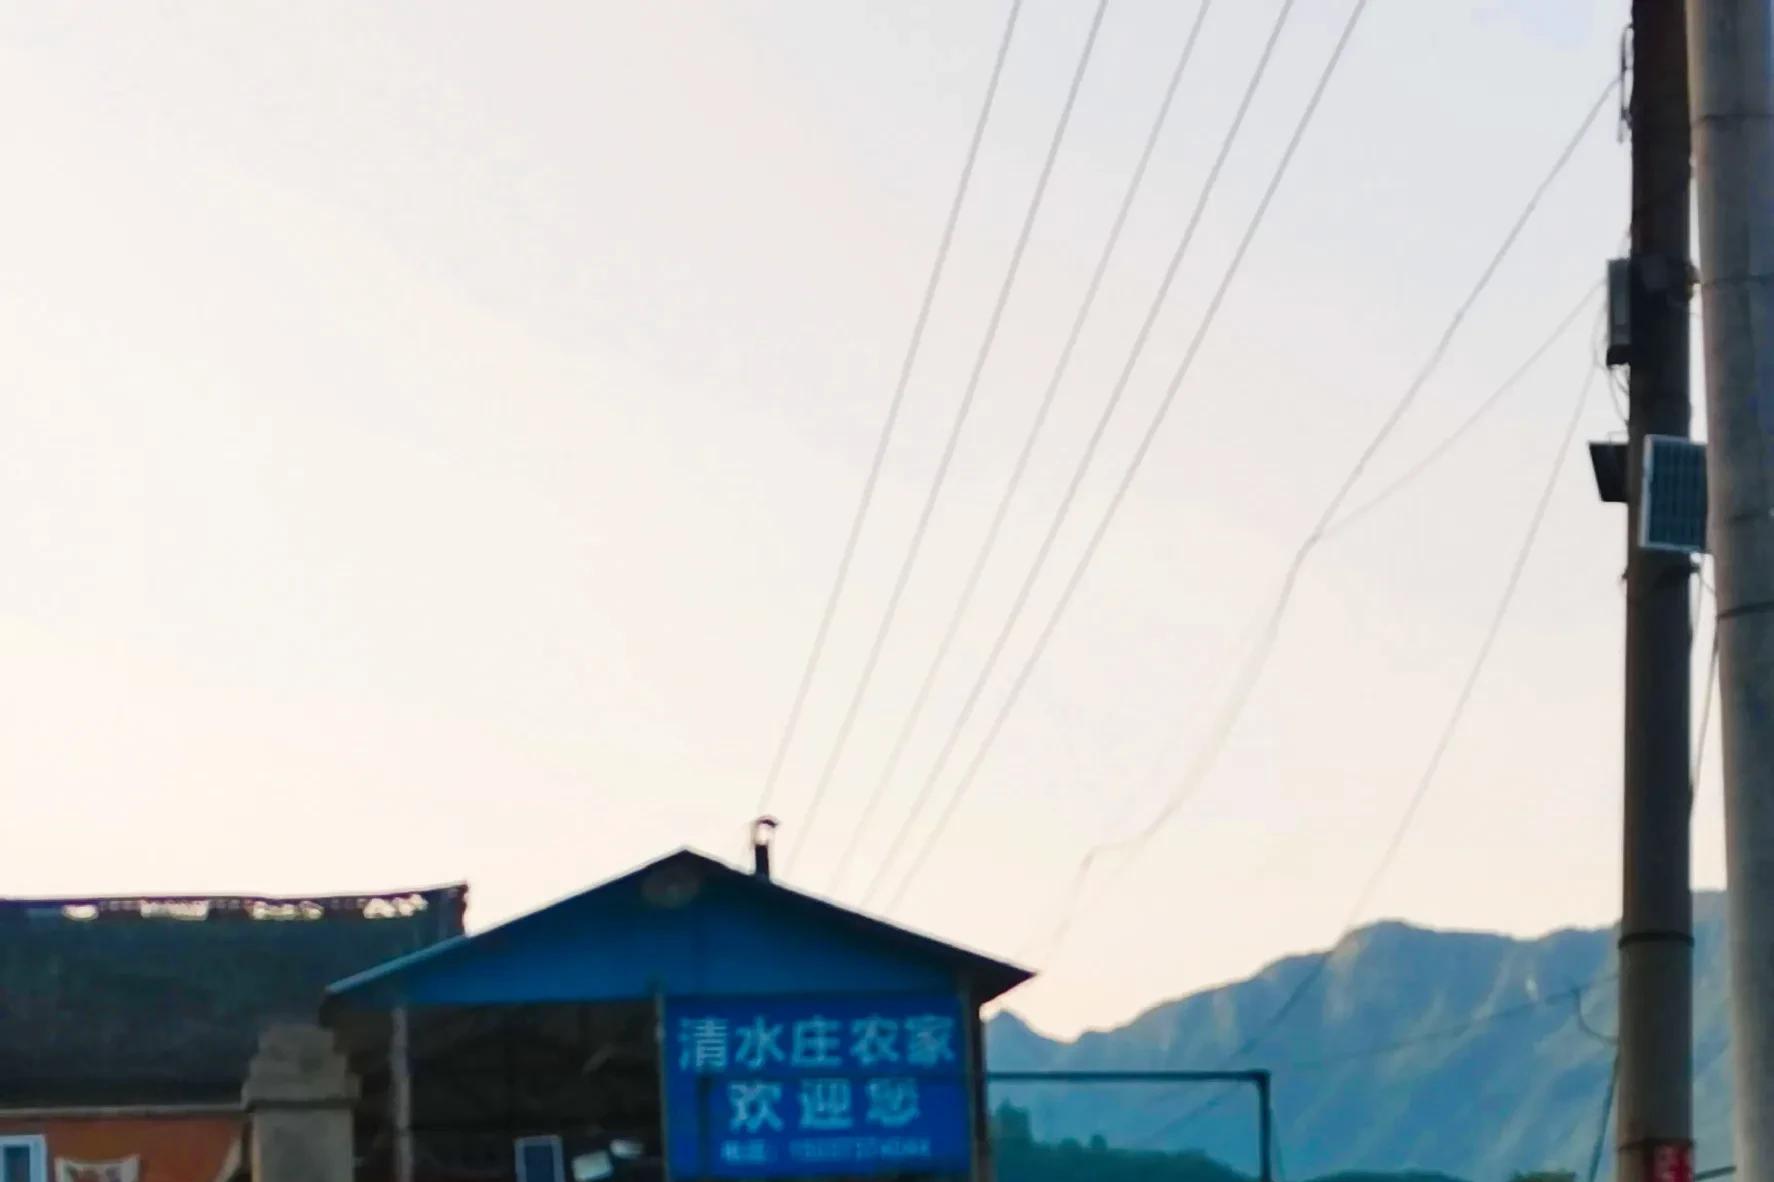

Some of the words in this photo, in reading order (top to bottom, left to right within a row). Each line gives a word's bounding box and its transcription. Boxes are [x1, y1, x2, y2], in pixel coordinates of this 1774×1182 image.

[677, 1014, 956, 1072] 清水庄农家
[726, 1077, 921, 1133] 欢迎您
